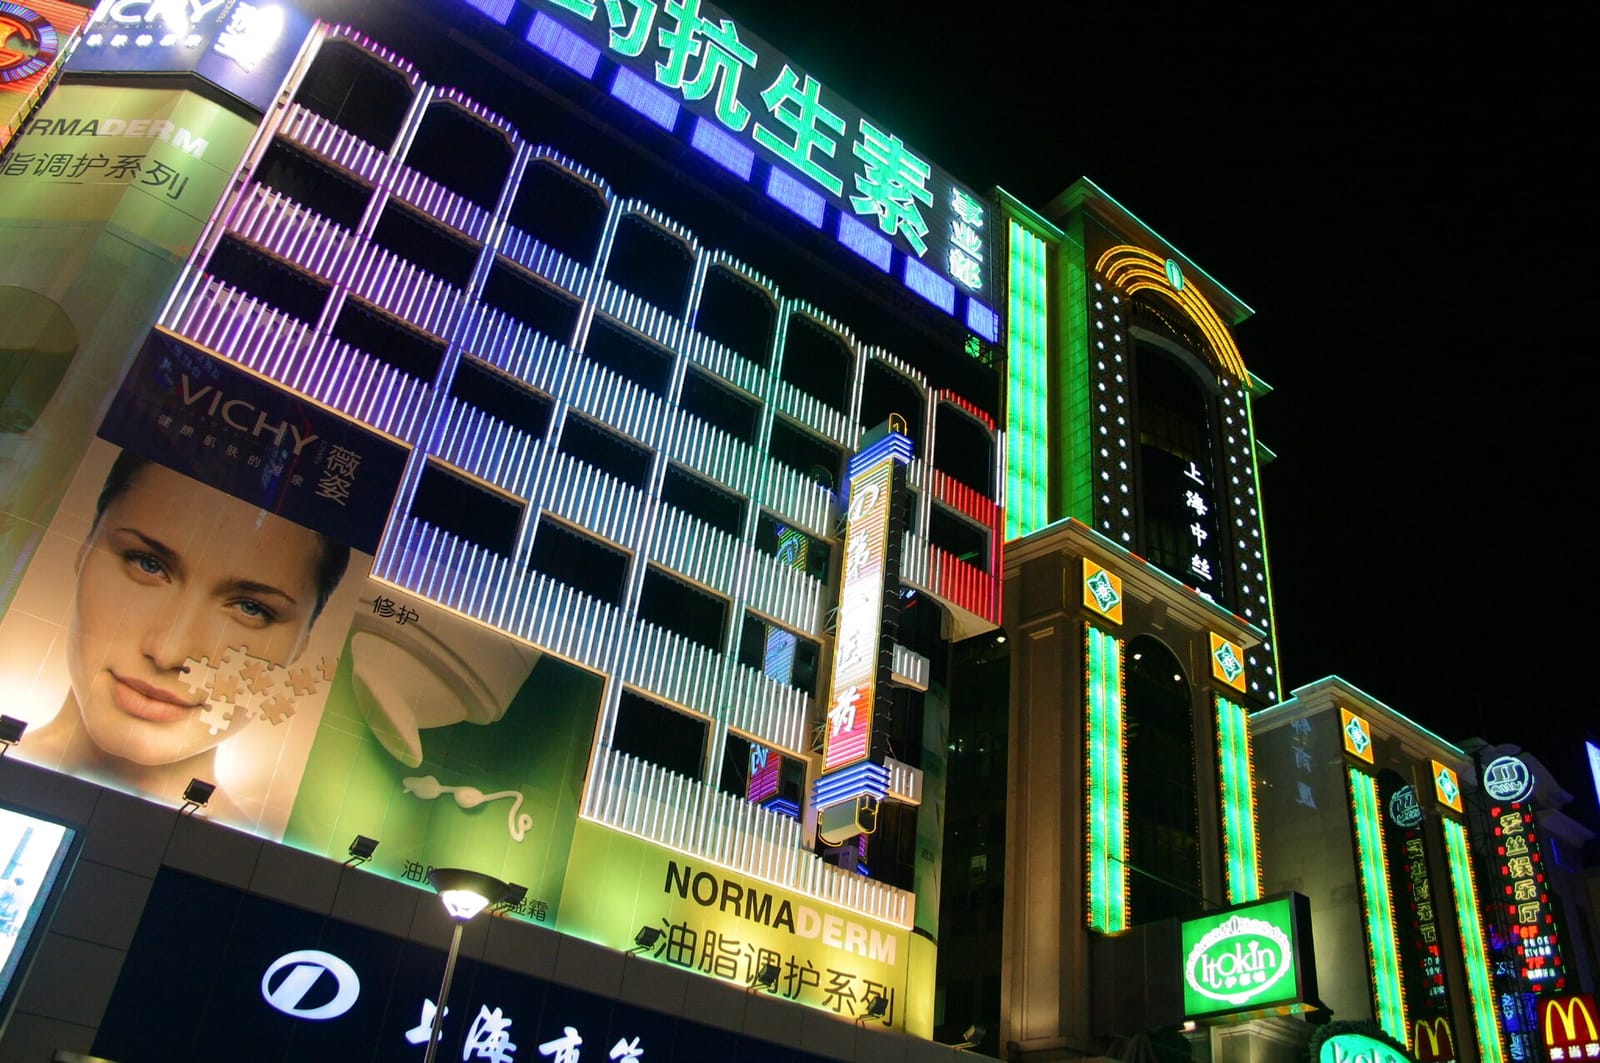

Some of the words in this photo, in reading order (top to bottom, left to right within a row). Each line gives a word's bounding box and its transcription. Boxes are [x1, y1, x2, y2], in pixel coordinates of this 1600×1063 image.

[182, 374, 319, 456] VICHY
[315, 444, 362, 507] 薇姿
[373, 595, 419, 625] 修护
[663, 860, 897, 967] NORMADERM
[654, 917, 895, 1027] 油脂调护系列
[1201, 940, 1276, 989] Itokin
